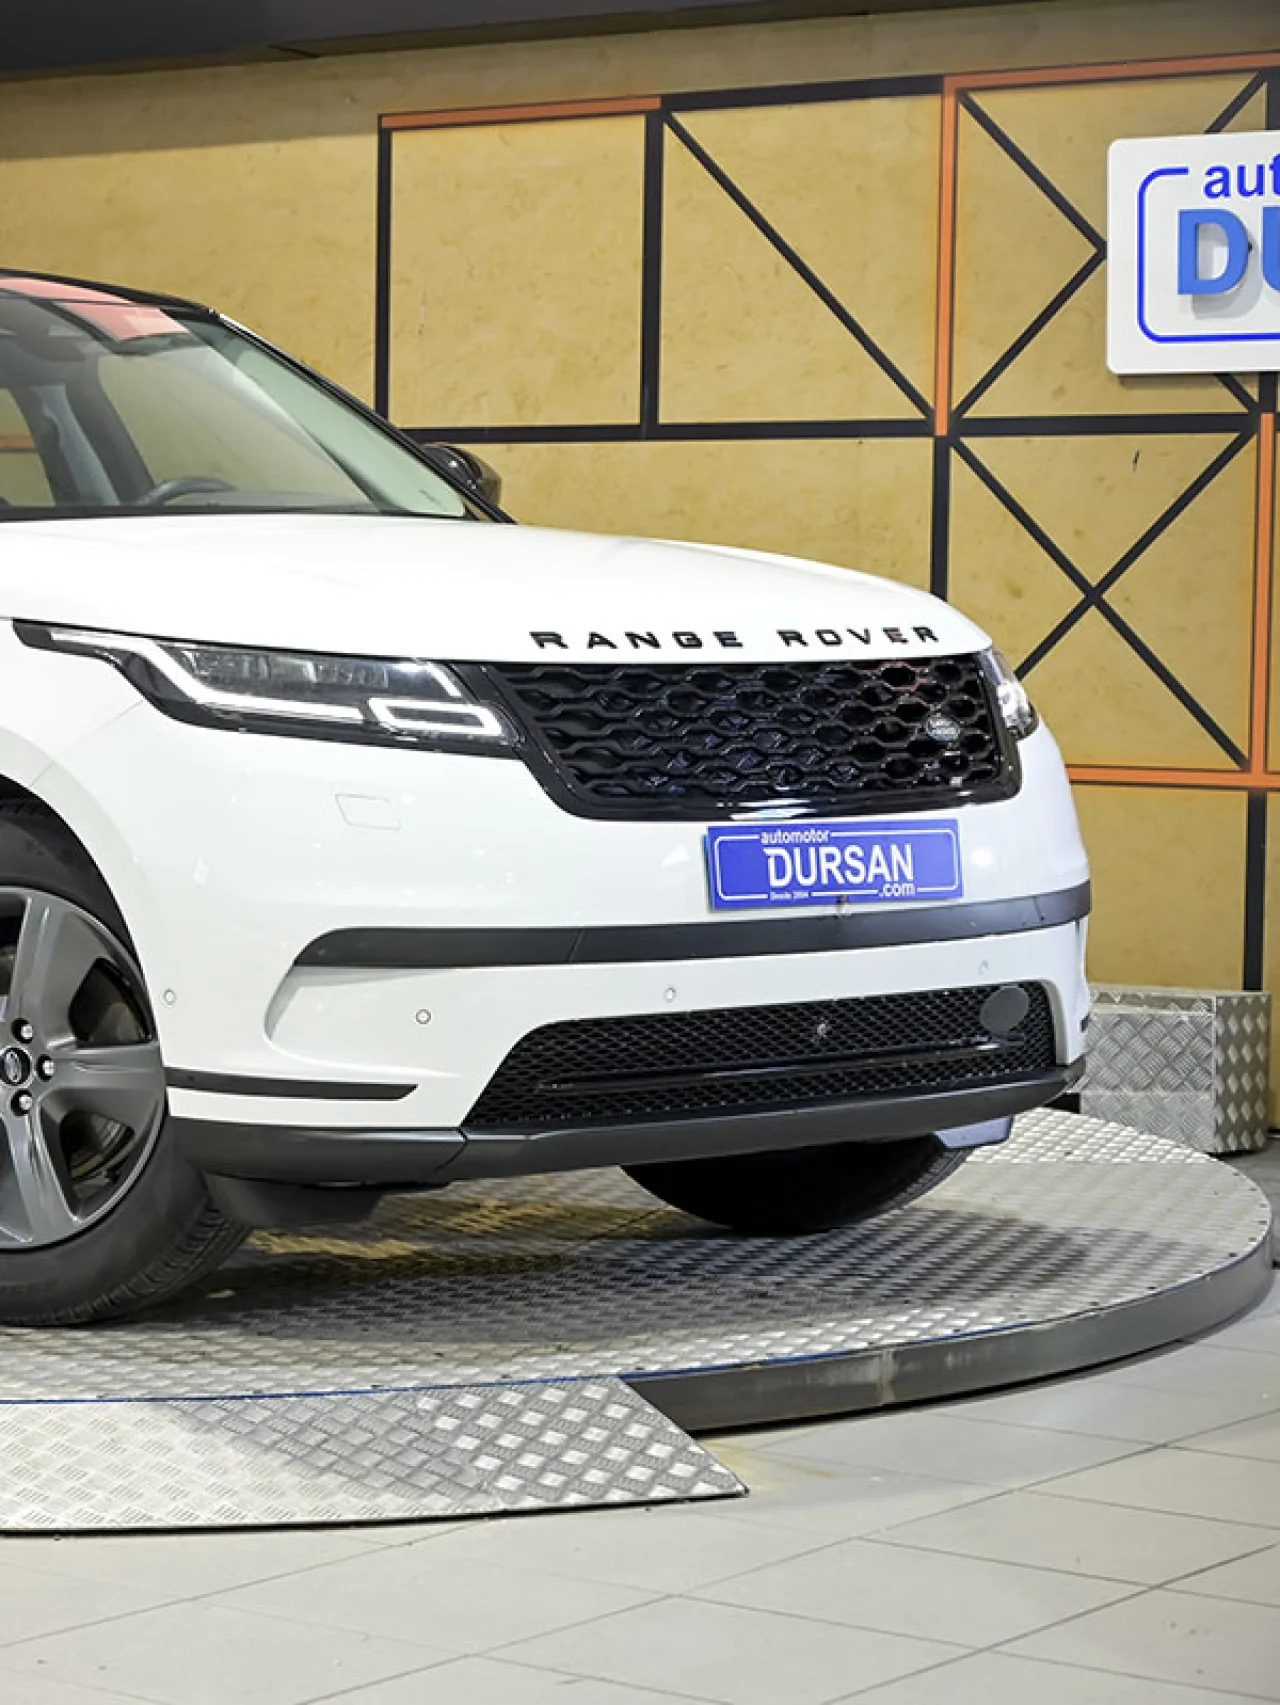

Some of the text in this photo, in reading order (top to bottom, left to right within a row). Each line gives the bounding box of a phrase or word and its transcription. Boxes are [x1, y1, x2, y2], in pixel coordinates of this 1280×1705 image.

[1177, 206, 1280, 295] D
[529, 626, 939, 649] RANGE ROVER
[760, 829, 829, 844] automotor
[763, 844, 914, 887] DURSAN
[879, 881, 916, 897] .com
